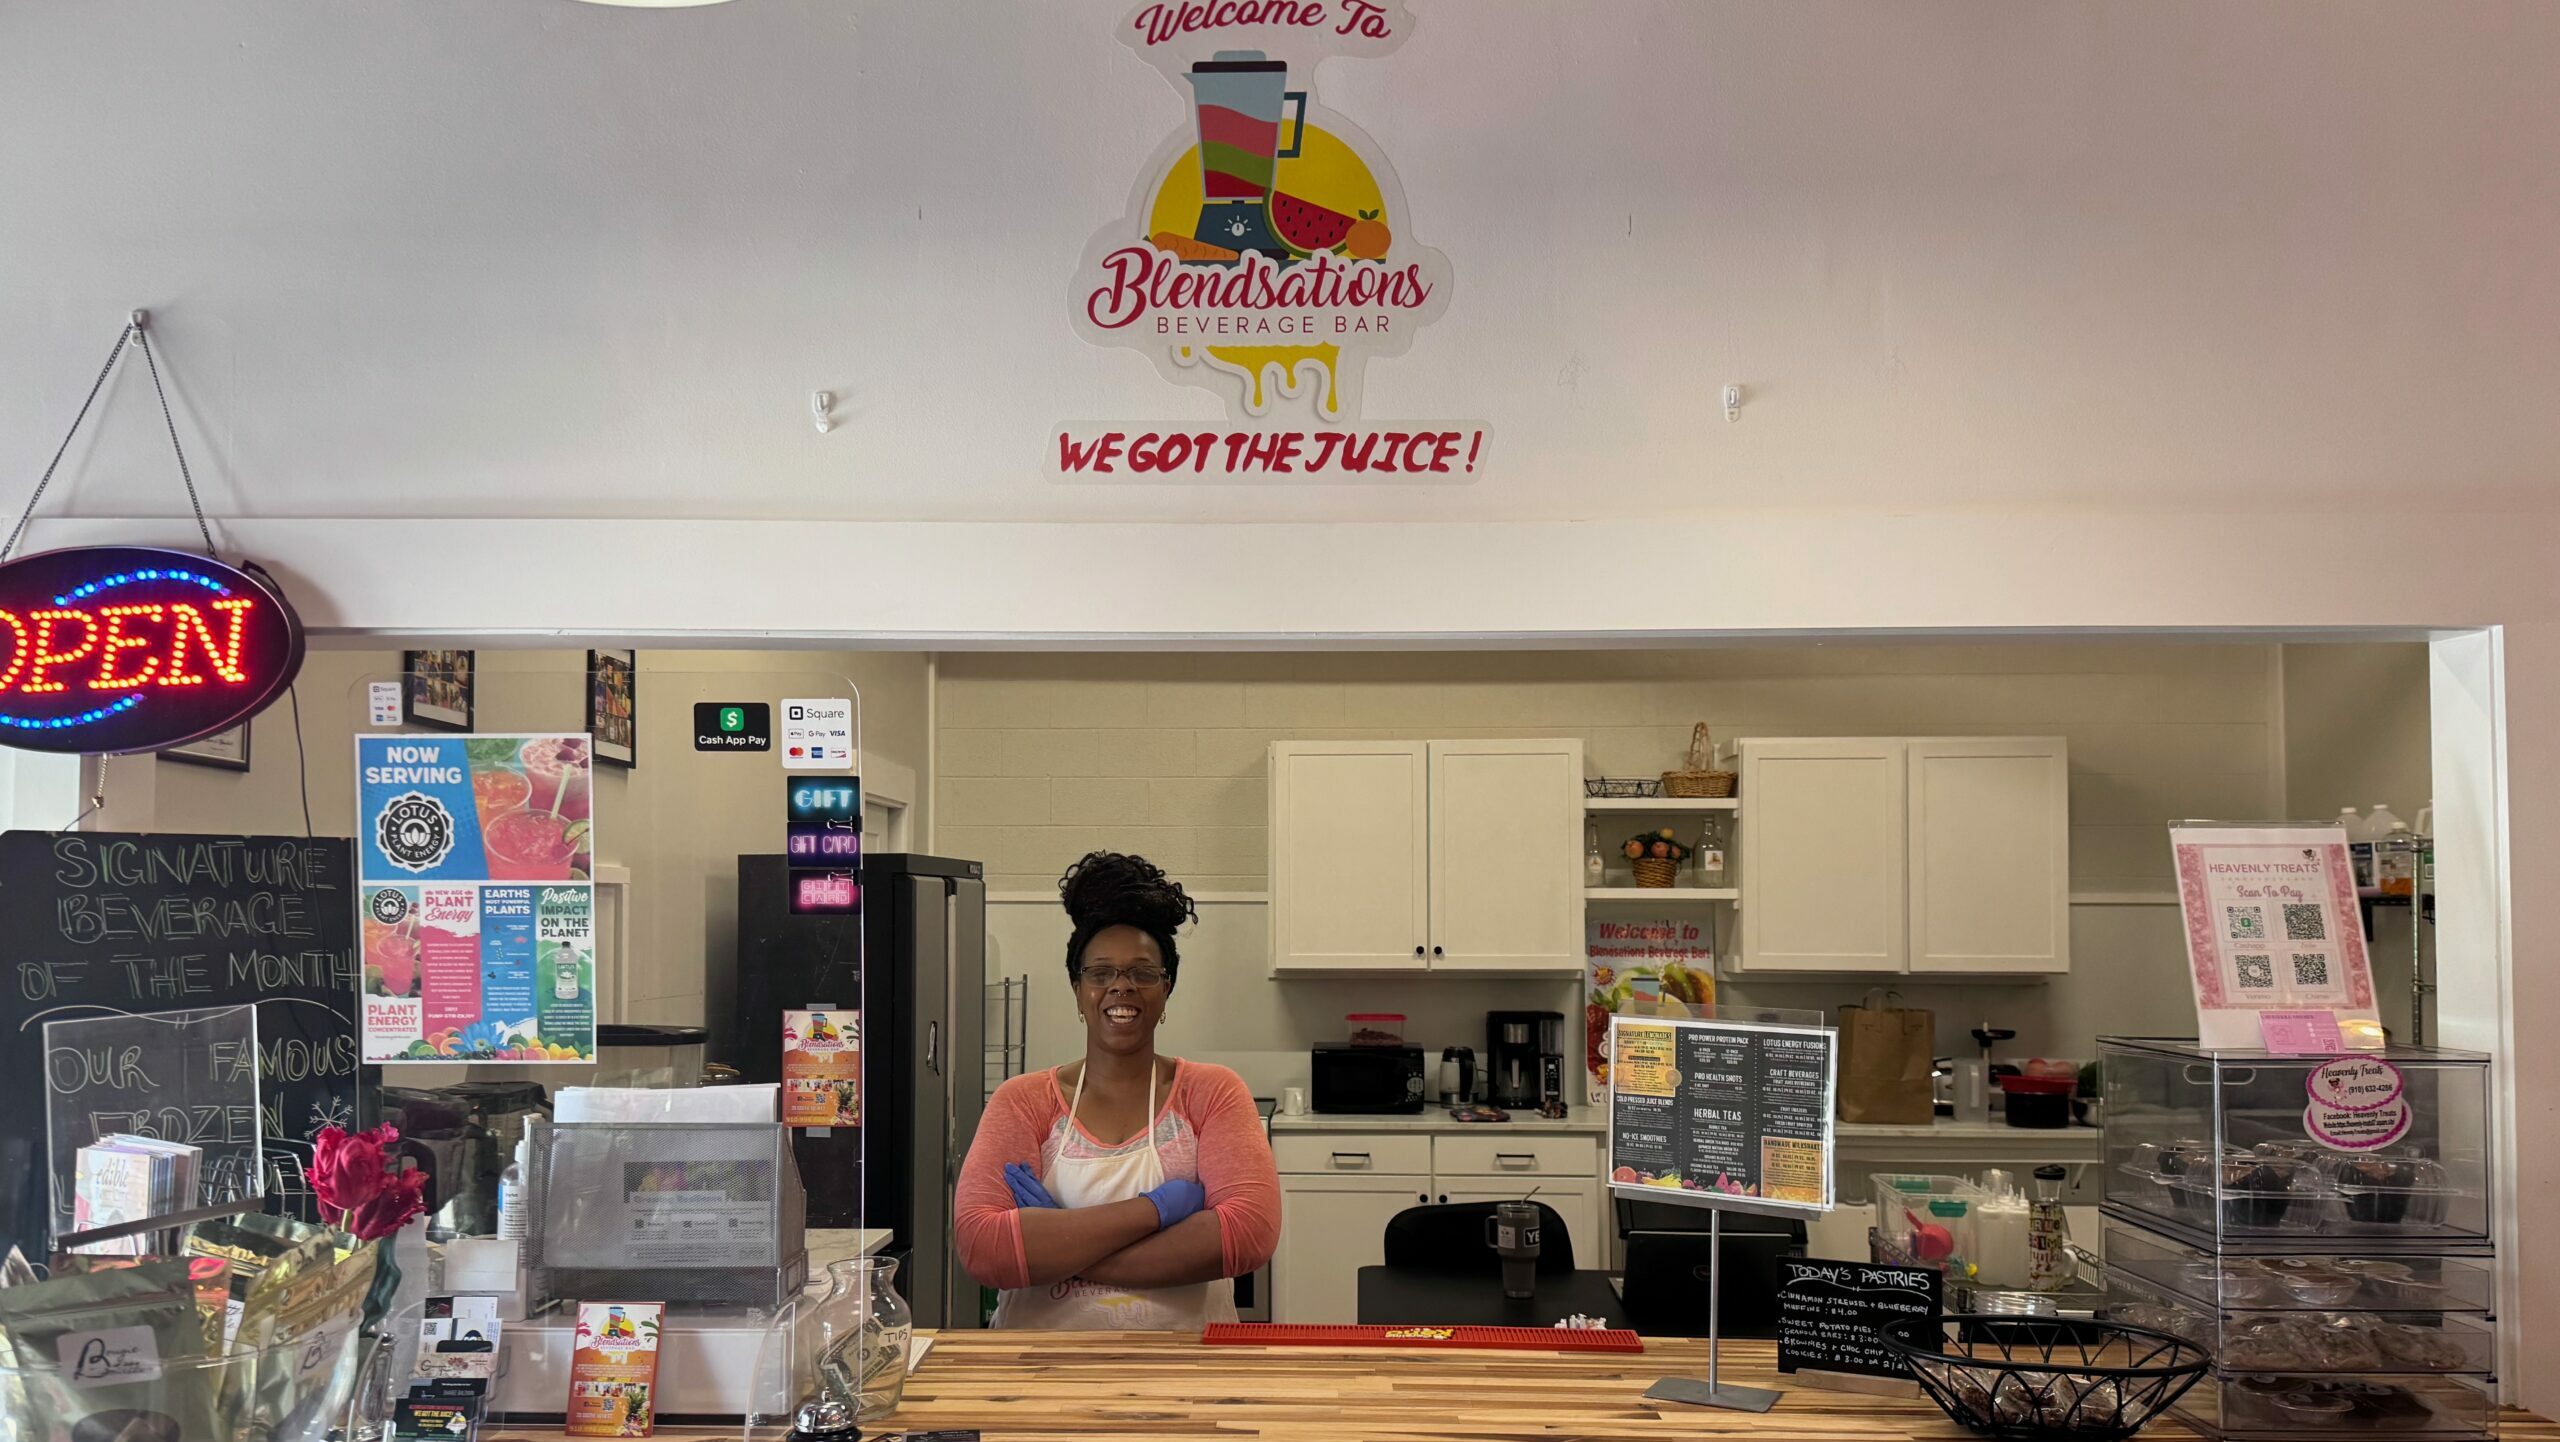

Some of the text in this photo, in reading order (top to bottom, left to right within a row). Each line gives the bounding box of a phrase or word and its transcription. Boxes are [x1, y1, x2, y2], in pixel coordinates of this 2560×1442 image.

[1135, 0, 1391, 45] Welcome To
[1087, 247, 1433, 328] Blendsations
[1157, 316, 1390, 334] BEVERAGE BAR
[1059, 432, 1125, 473] WE
[1128, 432, 1215, 473] GOT
[1224, 432, 1305, 473] THE
[806, 708, 844, 720] Square
[699, 736, 766, 748] Cash App Pay
[386, 746, 440, 763] NOW
[365, 767, 462, 784] SERVING
[795, 789, 853, 808] GIFT
[392, 805, 438, 824] LOTUS
[391, 834, 441, 858] PLANT ENERGY
[790, 835, 857, 854] GIFT CARD
[54, 838, 336, 890] SIGNATURE
[2209, 864, 2318, 873] HEAVENLY TREATS
[376, 889, 402, 902] LOTUS
[485, 889, 530, 899] EARTHS
[541, 887, 589, 905] Positive
[803, 893, 848, 903] CARD
[2237, 885, 2303, 902] Scan To Pay
[425, 897, 474, 907] PLANT
[57, 891, 316, 944] BEVERAGE
[425, 908, 474, 922] Energy
[485, 906, 530, 915] PLANTS
[541, 906, 588, 916] IMPACT
[541, 918, 589, 927] ON THE
[541, 928, 589, 938] PLANET
[1599, 923, 1699, 940] Welcome to
[1648, 946, 1688, 961] Beverage
[17, 948, 361, 1000] OF THE MONTH
[368, 1005, 416, 1015] PLANT
[368, 1017, 417, 1026] ENERGY
[800, 1039, 844, 1051] Blendsations
[1716, 1035, 1736, 1043] PROTEIN
[1763, 1039, 1781, 1047] LOTUS
[1782, 1040, 1802, 1048] ENERGY
[48, 1034, 359, 1094] OUR FAMOUS
[1695, 1072, 1705, 1080] PRO
[1706, 1073, 1725, 1081] HEALTH
[1789, 1070, 1819, 1079] BEVERAGES
[2321, 1064, 2384, 1080] Heavenly Treats
[2348, 1085, 2364, 1095] (910)
[1694, 1108, 1742, 1121] HERBAL TEAS
[1640, 1134, 1667, 1142] SMOOTHIES
[96, 1157, 129, 1188] edible
[1786, 1264, 1930, 1290] TODAY'S PASTRIES
[1780, 1291, 1823, 1303] CINNAMON
[1826, 1297, 1868, 1308] STREUSEL
[1878, 1302, 1928, 1315] BLUEBERRY
[1781, 1317, 1813, 1328] SWEET
[1819, 1322, 1850, 1331] POTATO
[884, 1329, 908, 1343] TIPS
[1784, 1328, 1818, 1336] GRANOLA
[591, 1336, 640, 1348] Blendsations
[1784, 1337, 1827, 1350] BROWNIES
[1840, 1345, 1860, 1353] CHOC
